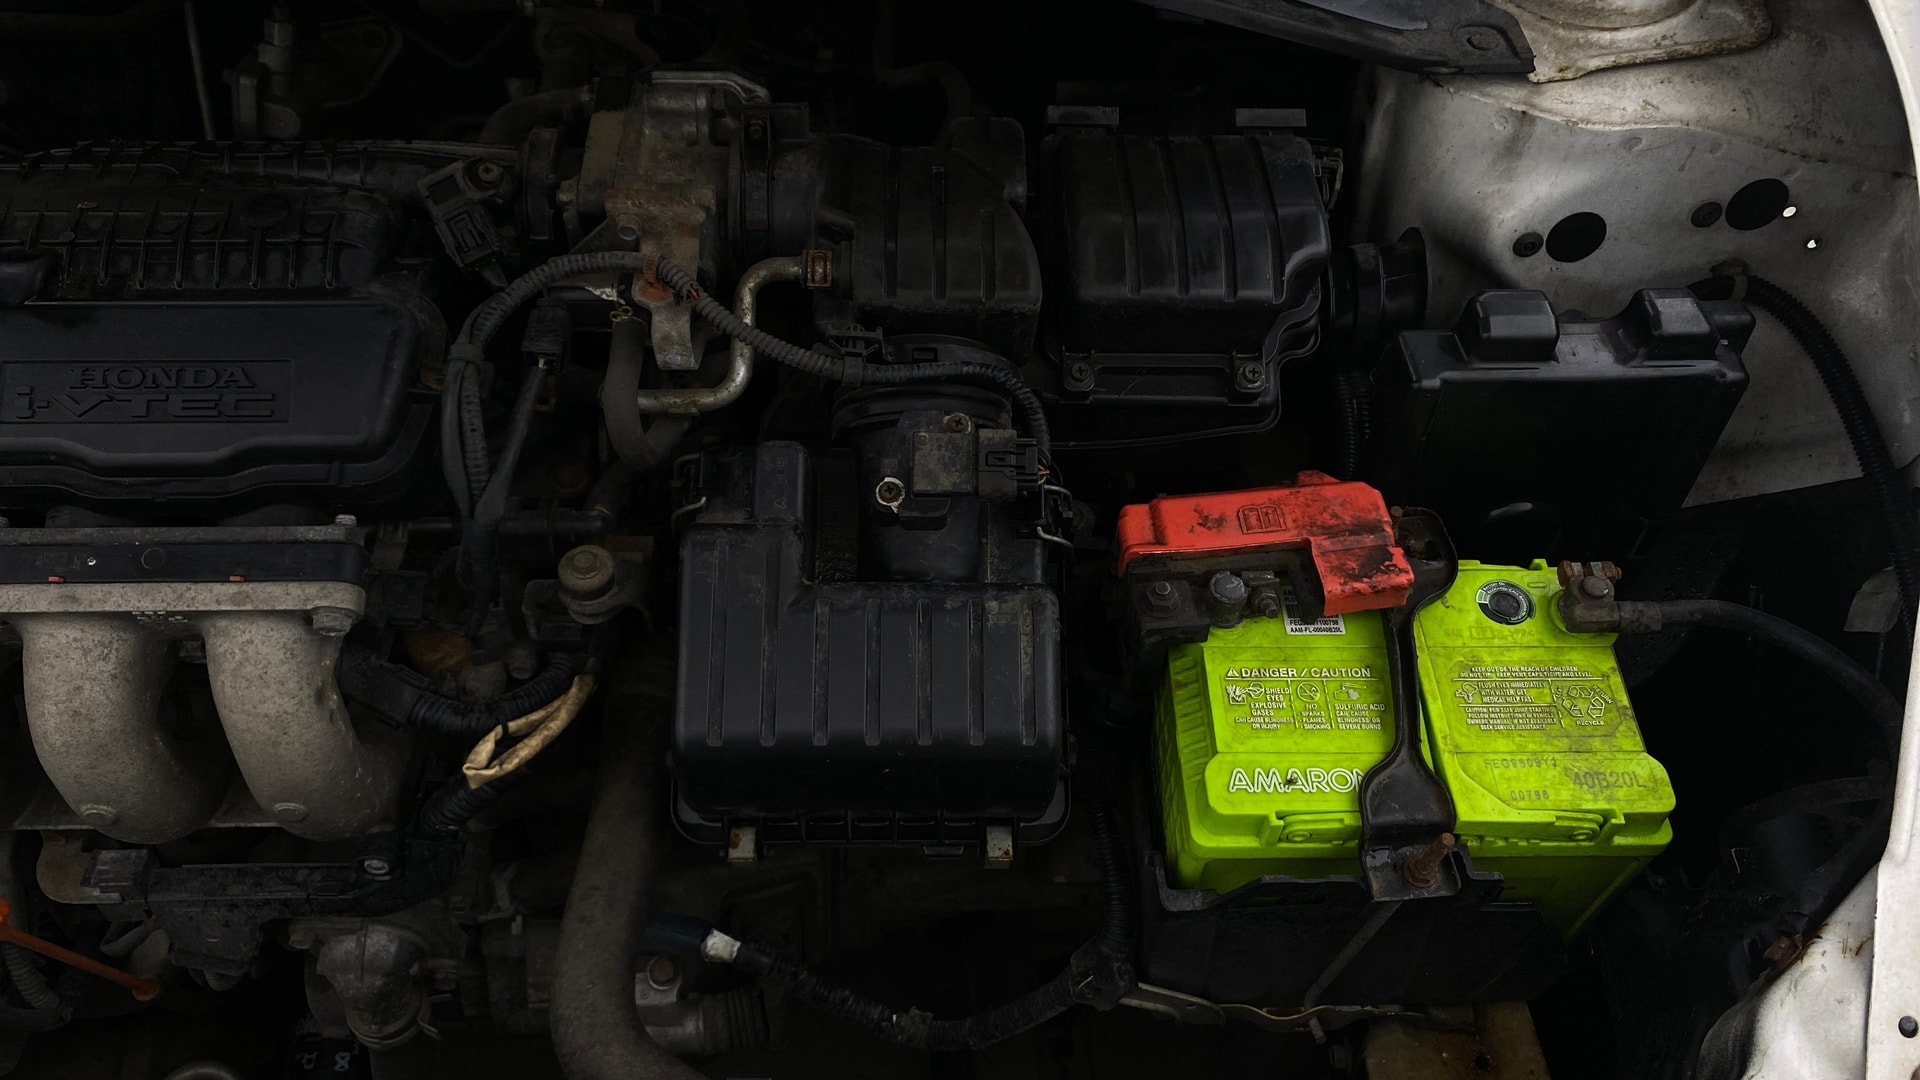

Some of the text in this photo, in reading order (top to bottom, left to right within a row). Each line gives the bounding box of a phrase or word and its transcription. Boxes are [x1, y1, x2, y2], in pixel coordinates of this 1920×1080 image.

[70, 368, 255, 389] HONDA
[1241, 668, 1297, 677] DANGER
[1311, 668, 1370, 677] CAUTION
[1592, 685, 1612, 704] RETURN
[1573, 771, 1647, 789] 40B20L
